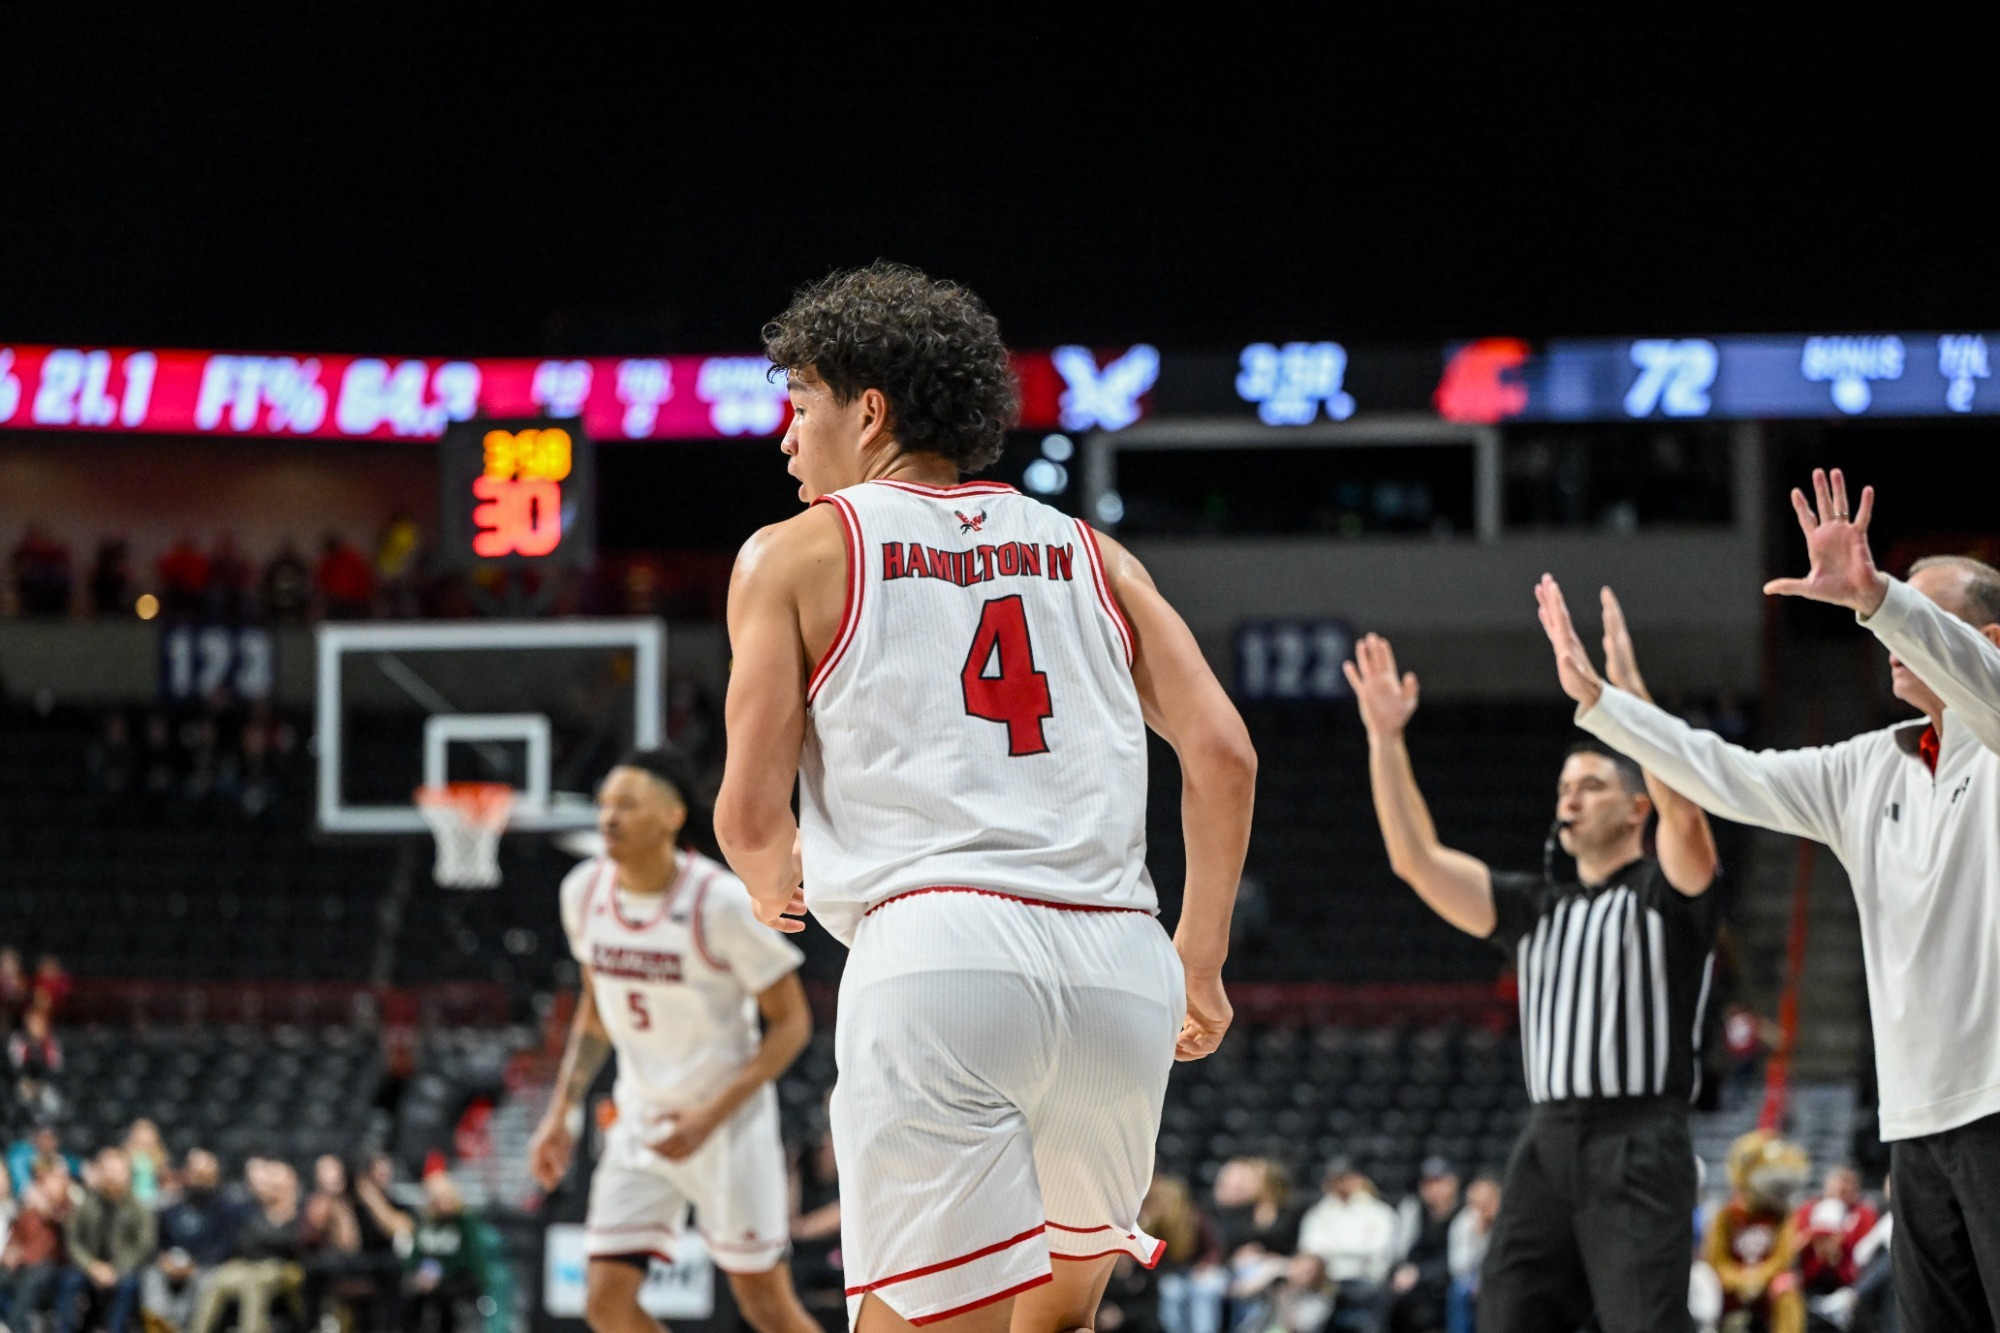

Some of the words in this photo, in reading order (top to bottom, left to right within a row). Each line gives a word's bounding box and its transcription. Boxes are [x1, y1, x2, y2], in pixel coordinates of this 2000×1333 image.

[1623, 338, 1719, 418] 72
[473, 474, 561, 557] 30
[881, 541, 1042, 588] HAMILTON
[1046, 541, 1074, 582] IV
[960, 593, 1054, 757] 4
[626, 990, 652, 1032] 5
